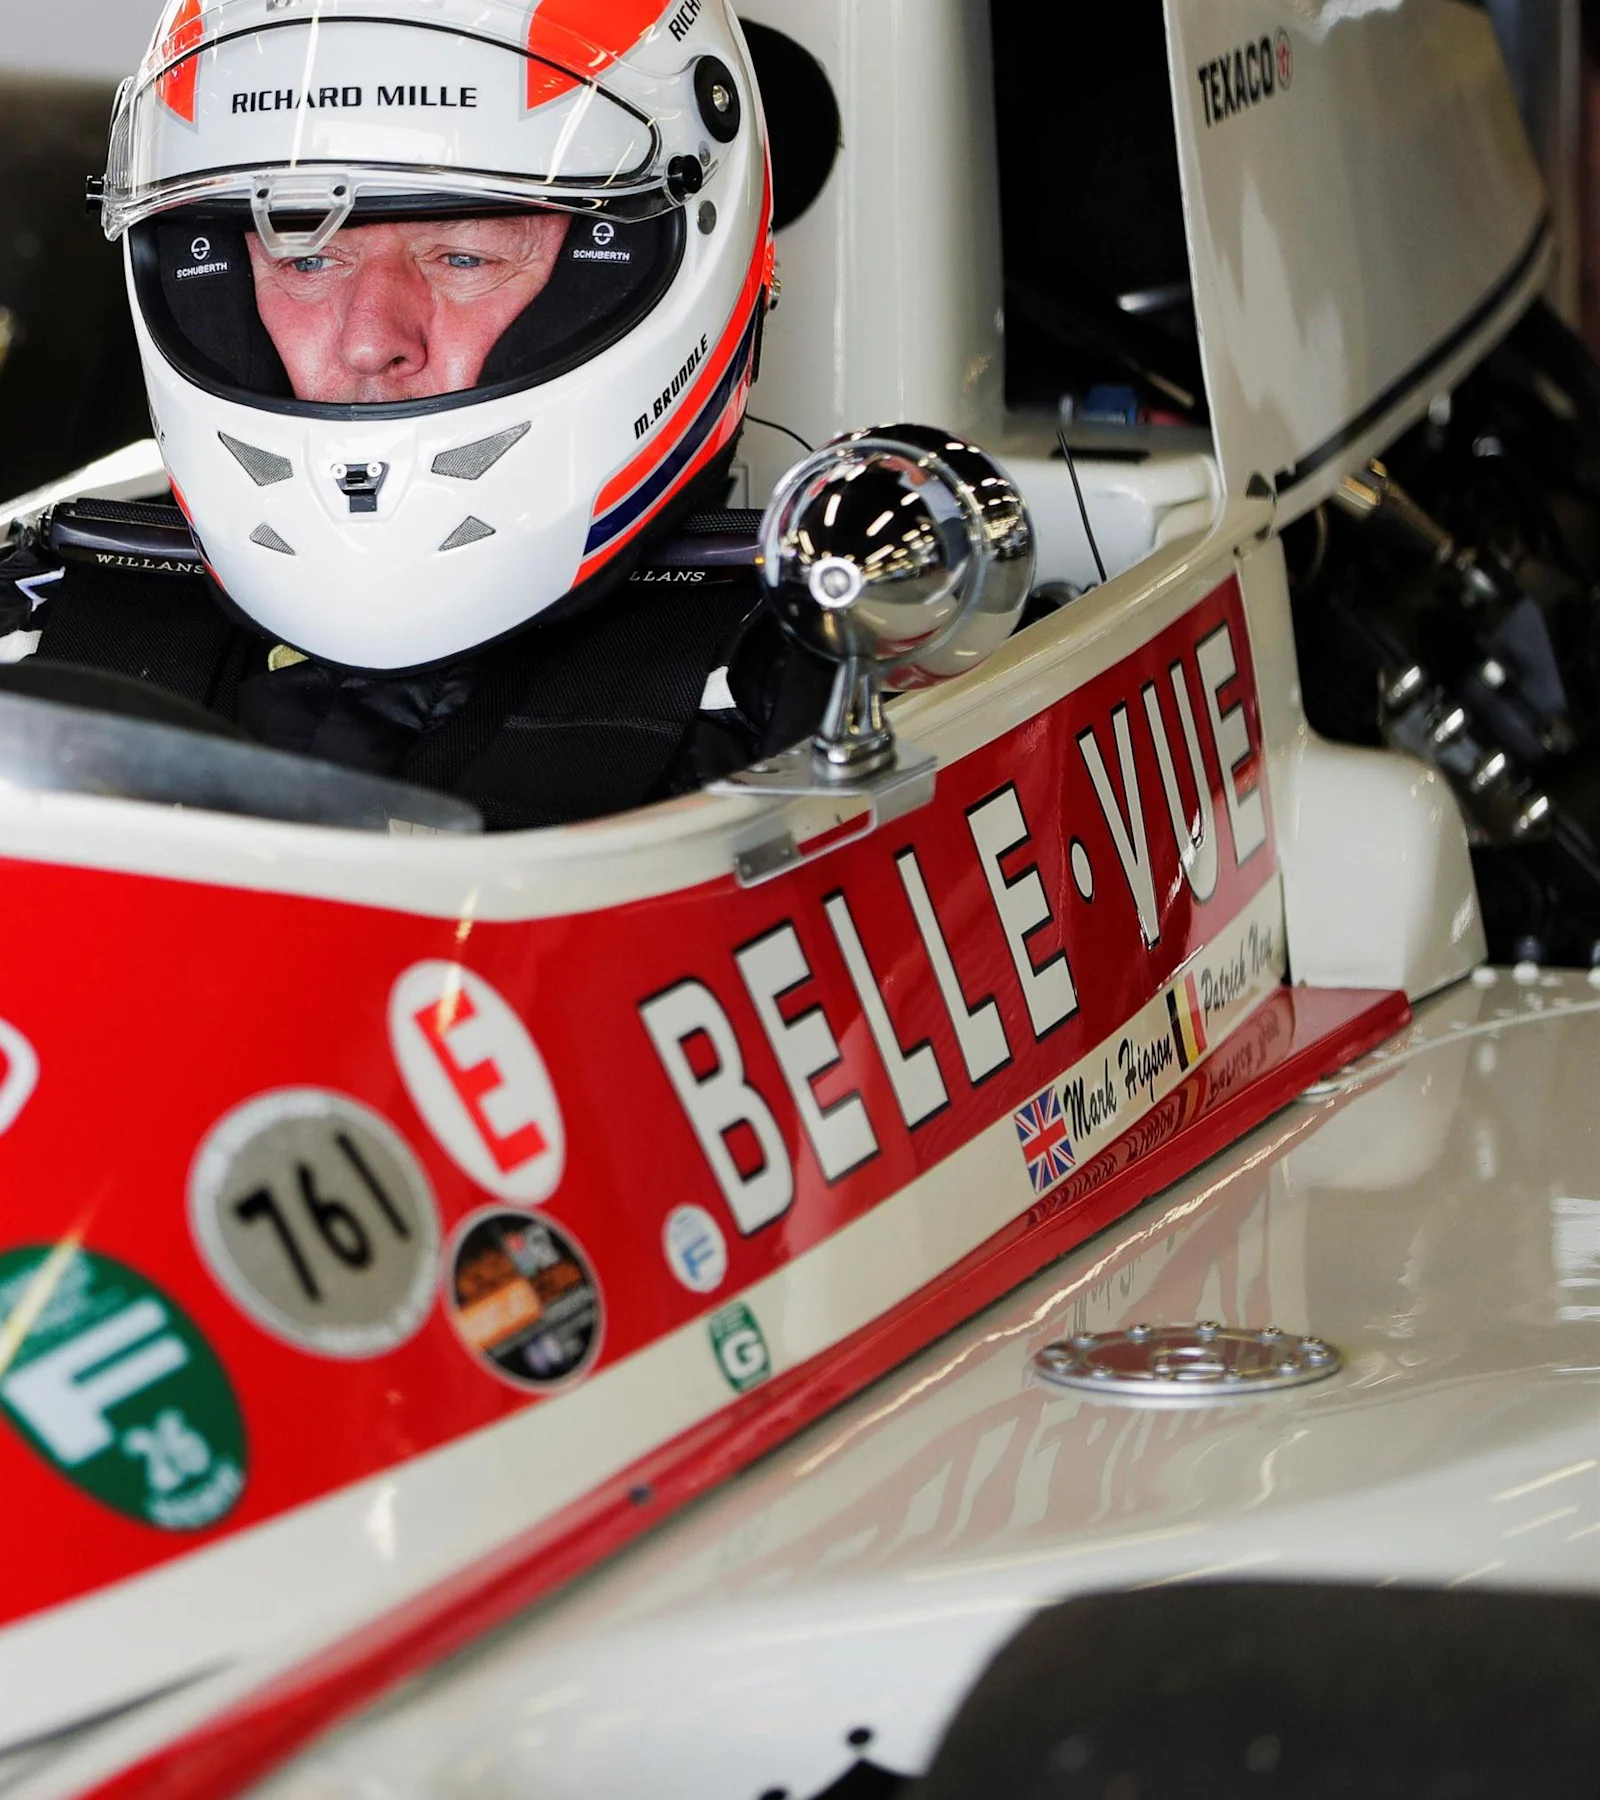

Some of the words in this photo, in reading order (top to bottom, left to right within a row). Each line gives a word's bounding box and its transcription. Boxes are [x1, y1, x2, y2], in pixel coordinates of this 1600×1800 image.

[668, 0, 703, 42] RICH
[1198, 35, 1274, 128] TEXACO
[231, 86, 362, 114] RICHARD
[377, 85, 477, 108] MILLE
[176, 261, 228, 278] SCHUBERTH
[572, 249, 631, 261] SCHUBERTH
[633, 333, 708, 440] M.BRUNDLE
[96, 553, 206, 575] WILLANS
[628, 570, 706, 582] LLANS
[1063, 1057, 1118, 1143] Mark
[1118, 1032, 1174, 1103] Higson
[232, 1132, 411, 1305] 761
